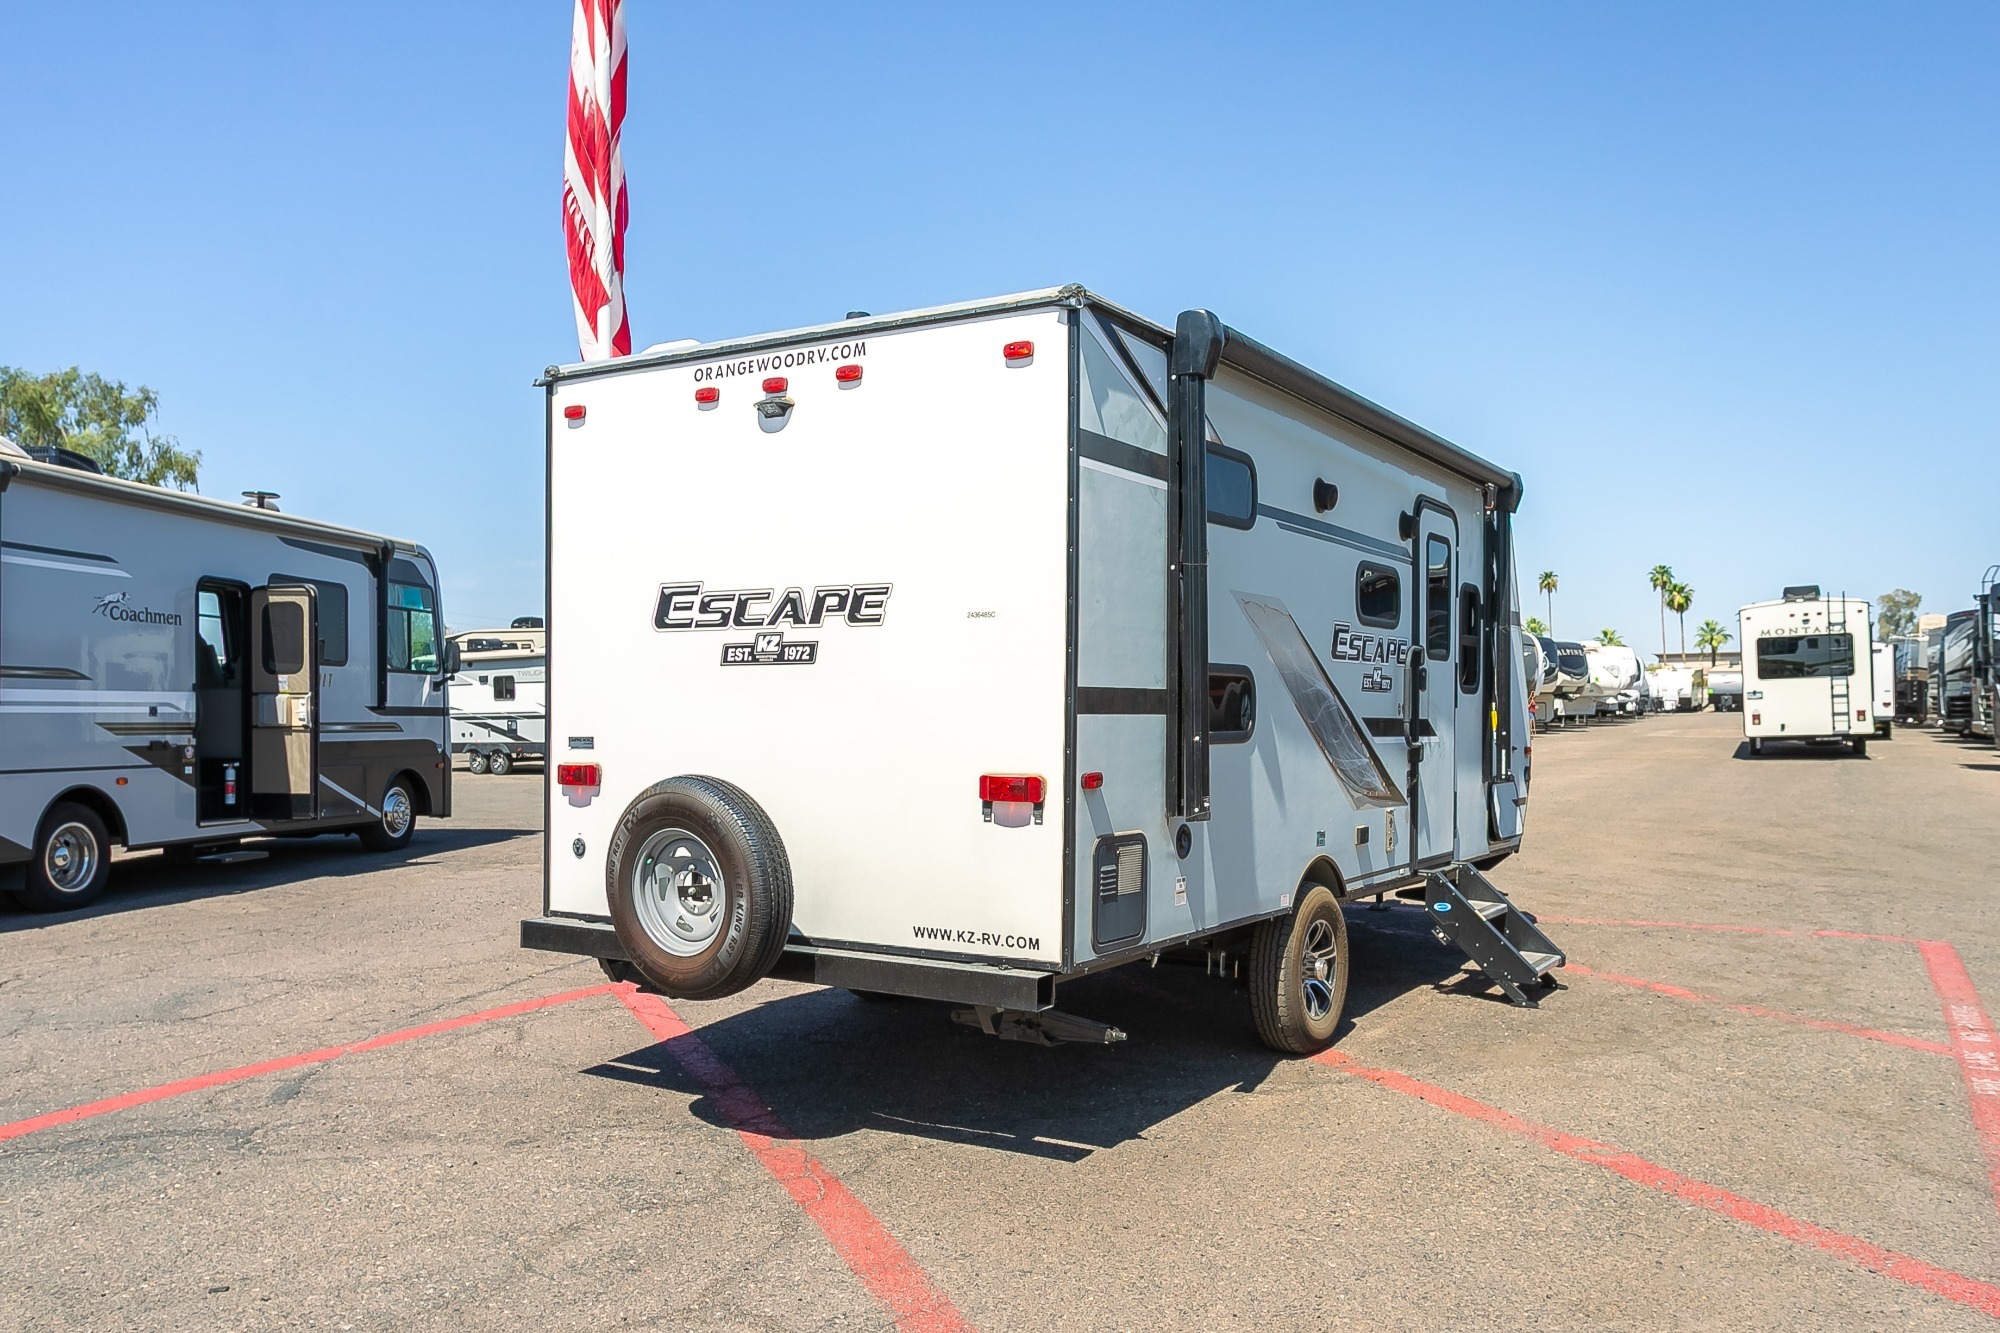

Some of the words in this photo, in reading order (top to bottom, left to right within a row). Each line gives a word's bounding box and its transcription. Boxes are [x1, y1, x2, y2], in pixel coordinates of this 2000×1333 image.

[693, 341, 867, 382] ORANGEWOODRV.COM
[109, 605, 182, 626] Coachmen
[653, 583, 892, 630] ESCAPE
[726, 647, 752, 662] EST.
[783, 645, 811, 661] 1972
[756, 634, 781, 653] KZ
[1331, 621, 1408, 665] ESCAPE
[733, 901, 745, 934] KING
[912, 925, 1040, 950] WWW.KZ-RV.COM
